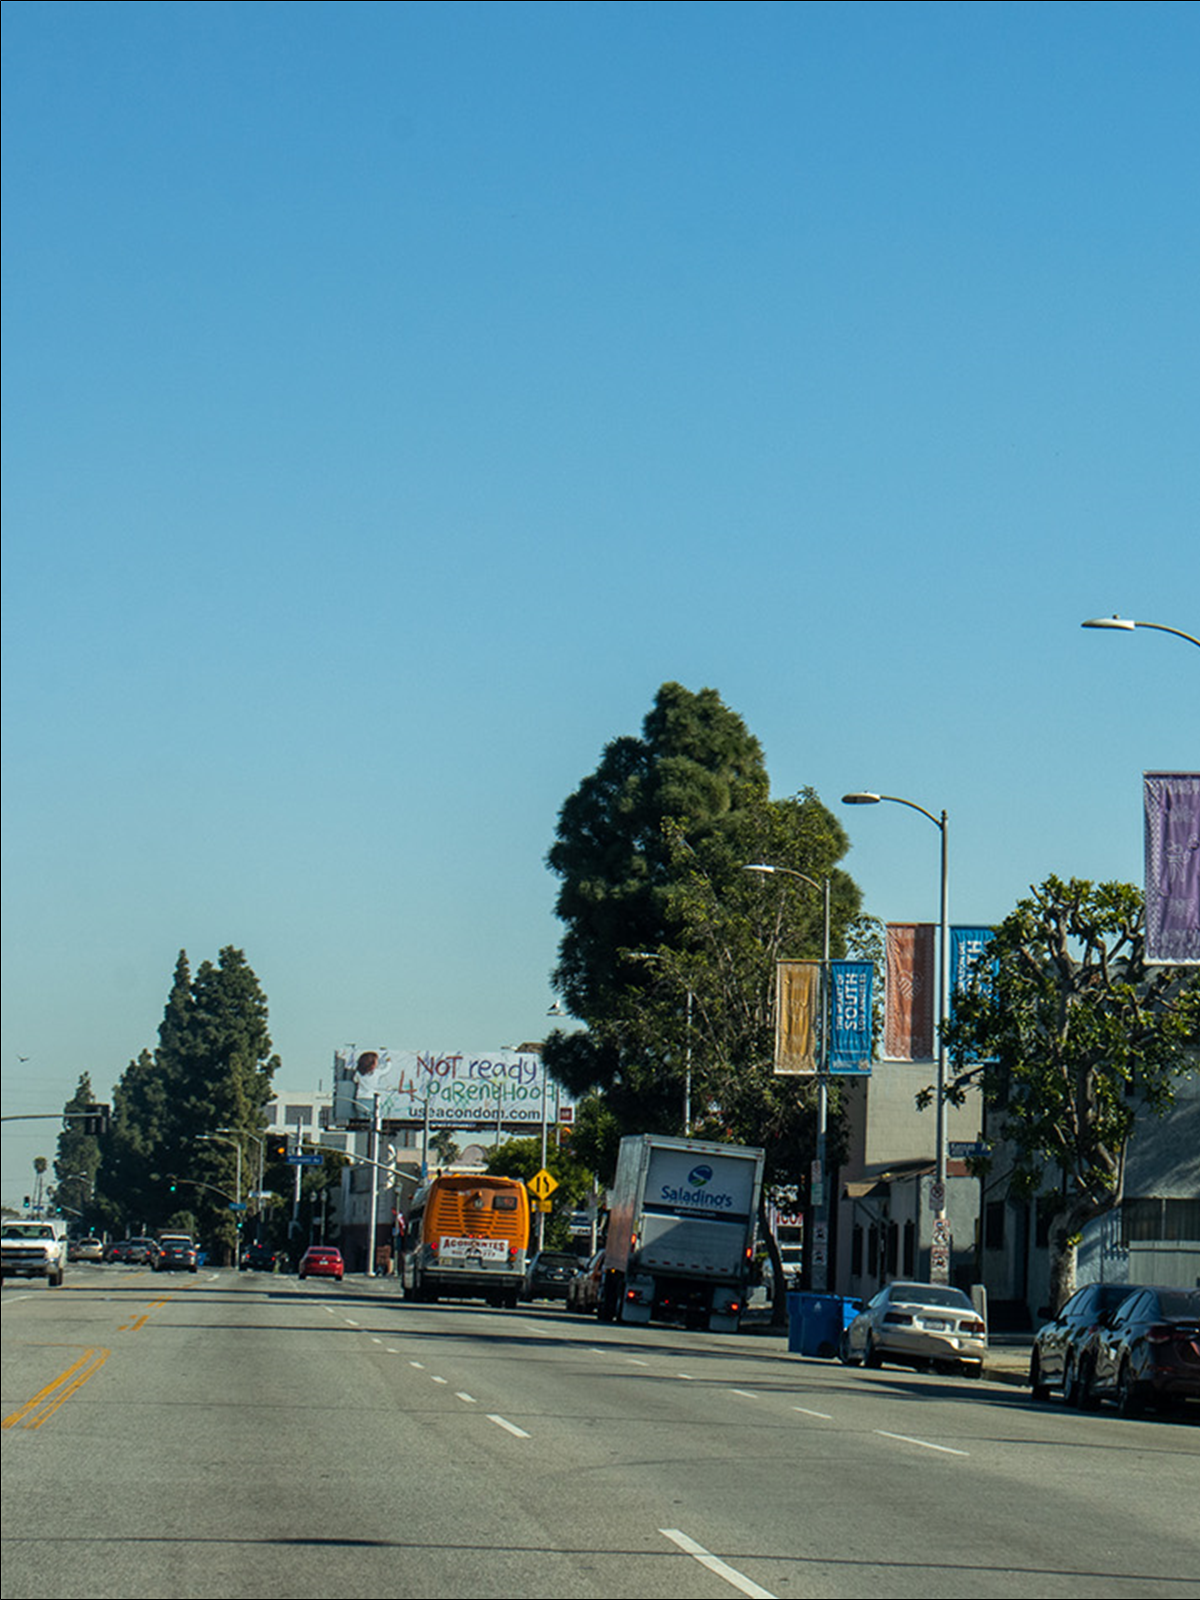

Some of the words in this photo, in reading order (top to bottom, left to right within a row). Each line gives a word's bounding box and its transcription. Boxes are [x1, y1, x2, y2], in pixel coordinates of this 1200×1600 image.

[844, 973, 858, 1032] SOUTH
[416, 1055, 464, 1080] NOT
[468, 1057, 538, 1085] ready
[397, 1070, 418, 1102] 4
[661, 1185, 733, 1208] Saladino's
